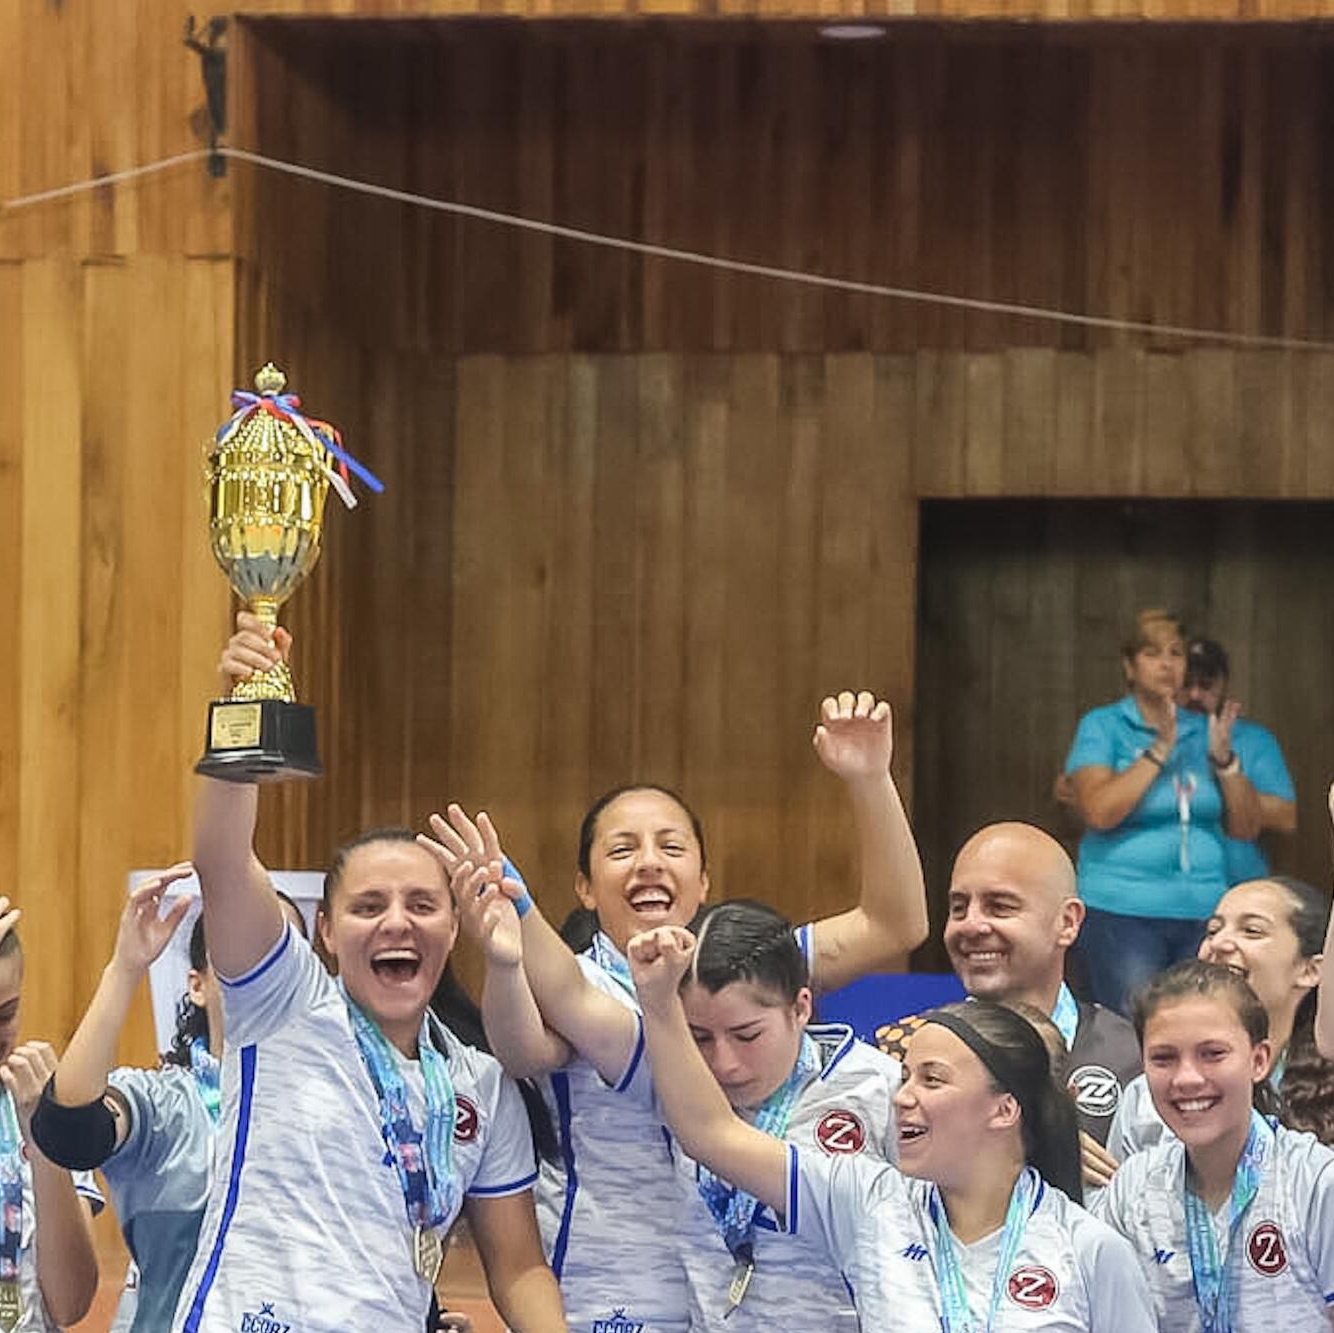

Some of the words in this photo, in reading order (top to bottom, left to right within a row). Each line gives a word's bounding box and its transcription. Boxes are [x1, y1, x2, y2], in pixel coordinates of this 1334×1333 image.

[825, 1118, 856, 1149] Z
[1256, 1233, 1280, 1266] Z
[1017, 1272, 1048, 1302] Z
